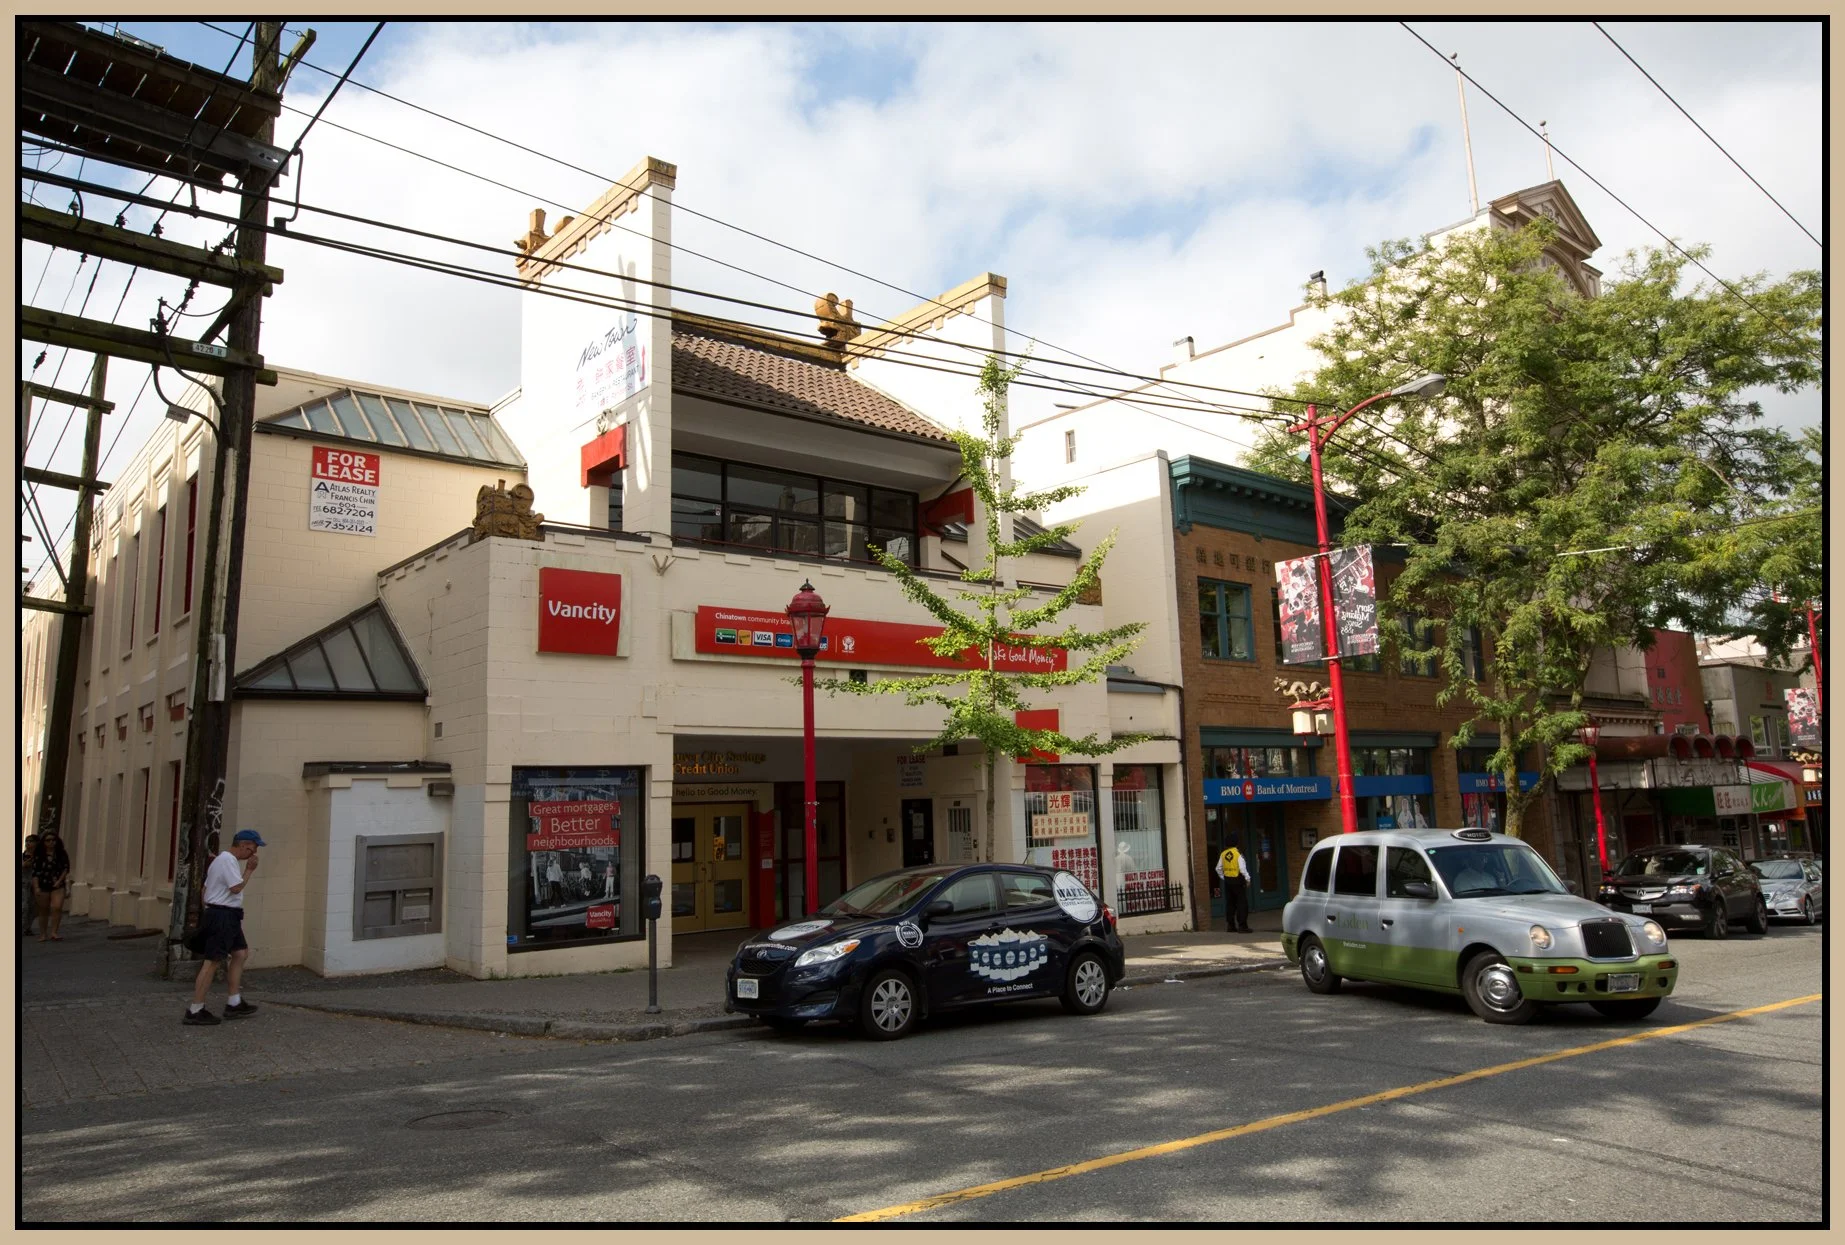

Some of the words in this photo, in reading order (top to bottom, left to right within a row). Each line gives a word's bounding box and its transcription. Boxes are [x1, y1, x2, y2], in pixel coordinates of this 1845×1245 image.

[576, 341, 603, 371] New
[604, 318, 637, 351] Town
[327, 451, 366, 468] FOR
[316, 463, 376, 483] LEASE
[548, 600, 616, 624] Vancity
[715, 612, 747, 621] Chinatown
[747, 616, 780, 626] community
[756, 633, 772, 642] VISA
[1009, 646, 1027, 662] Good
[673, 763, 707, 774] Credit
[709, 763, 739, 774] Union
[1220, 785, 1241, 796] BMO
[1257, 784, 1276, 795] Bank
[1277, 784, 1285, 794] of
[1285, 783, 1318, 794] Montreal
[1475, 778, 1488, 787] BMO
[676, 787, 695, 797] hello
[708, 787, 729, 796] Good
[533, 804, 562, 815] Great
[563, 802, 616, 814] mortgages.
[1049, 794, 1071, 809] 光輝
[551, 817, 601, 833] Better
[533, 835, 617, 849] neighbourhoods.
[589, 910, 612, 919] Vancity
[993, 985, 1007, 993] Place
[1012, 982, 1033, 992] Connect
